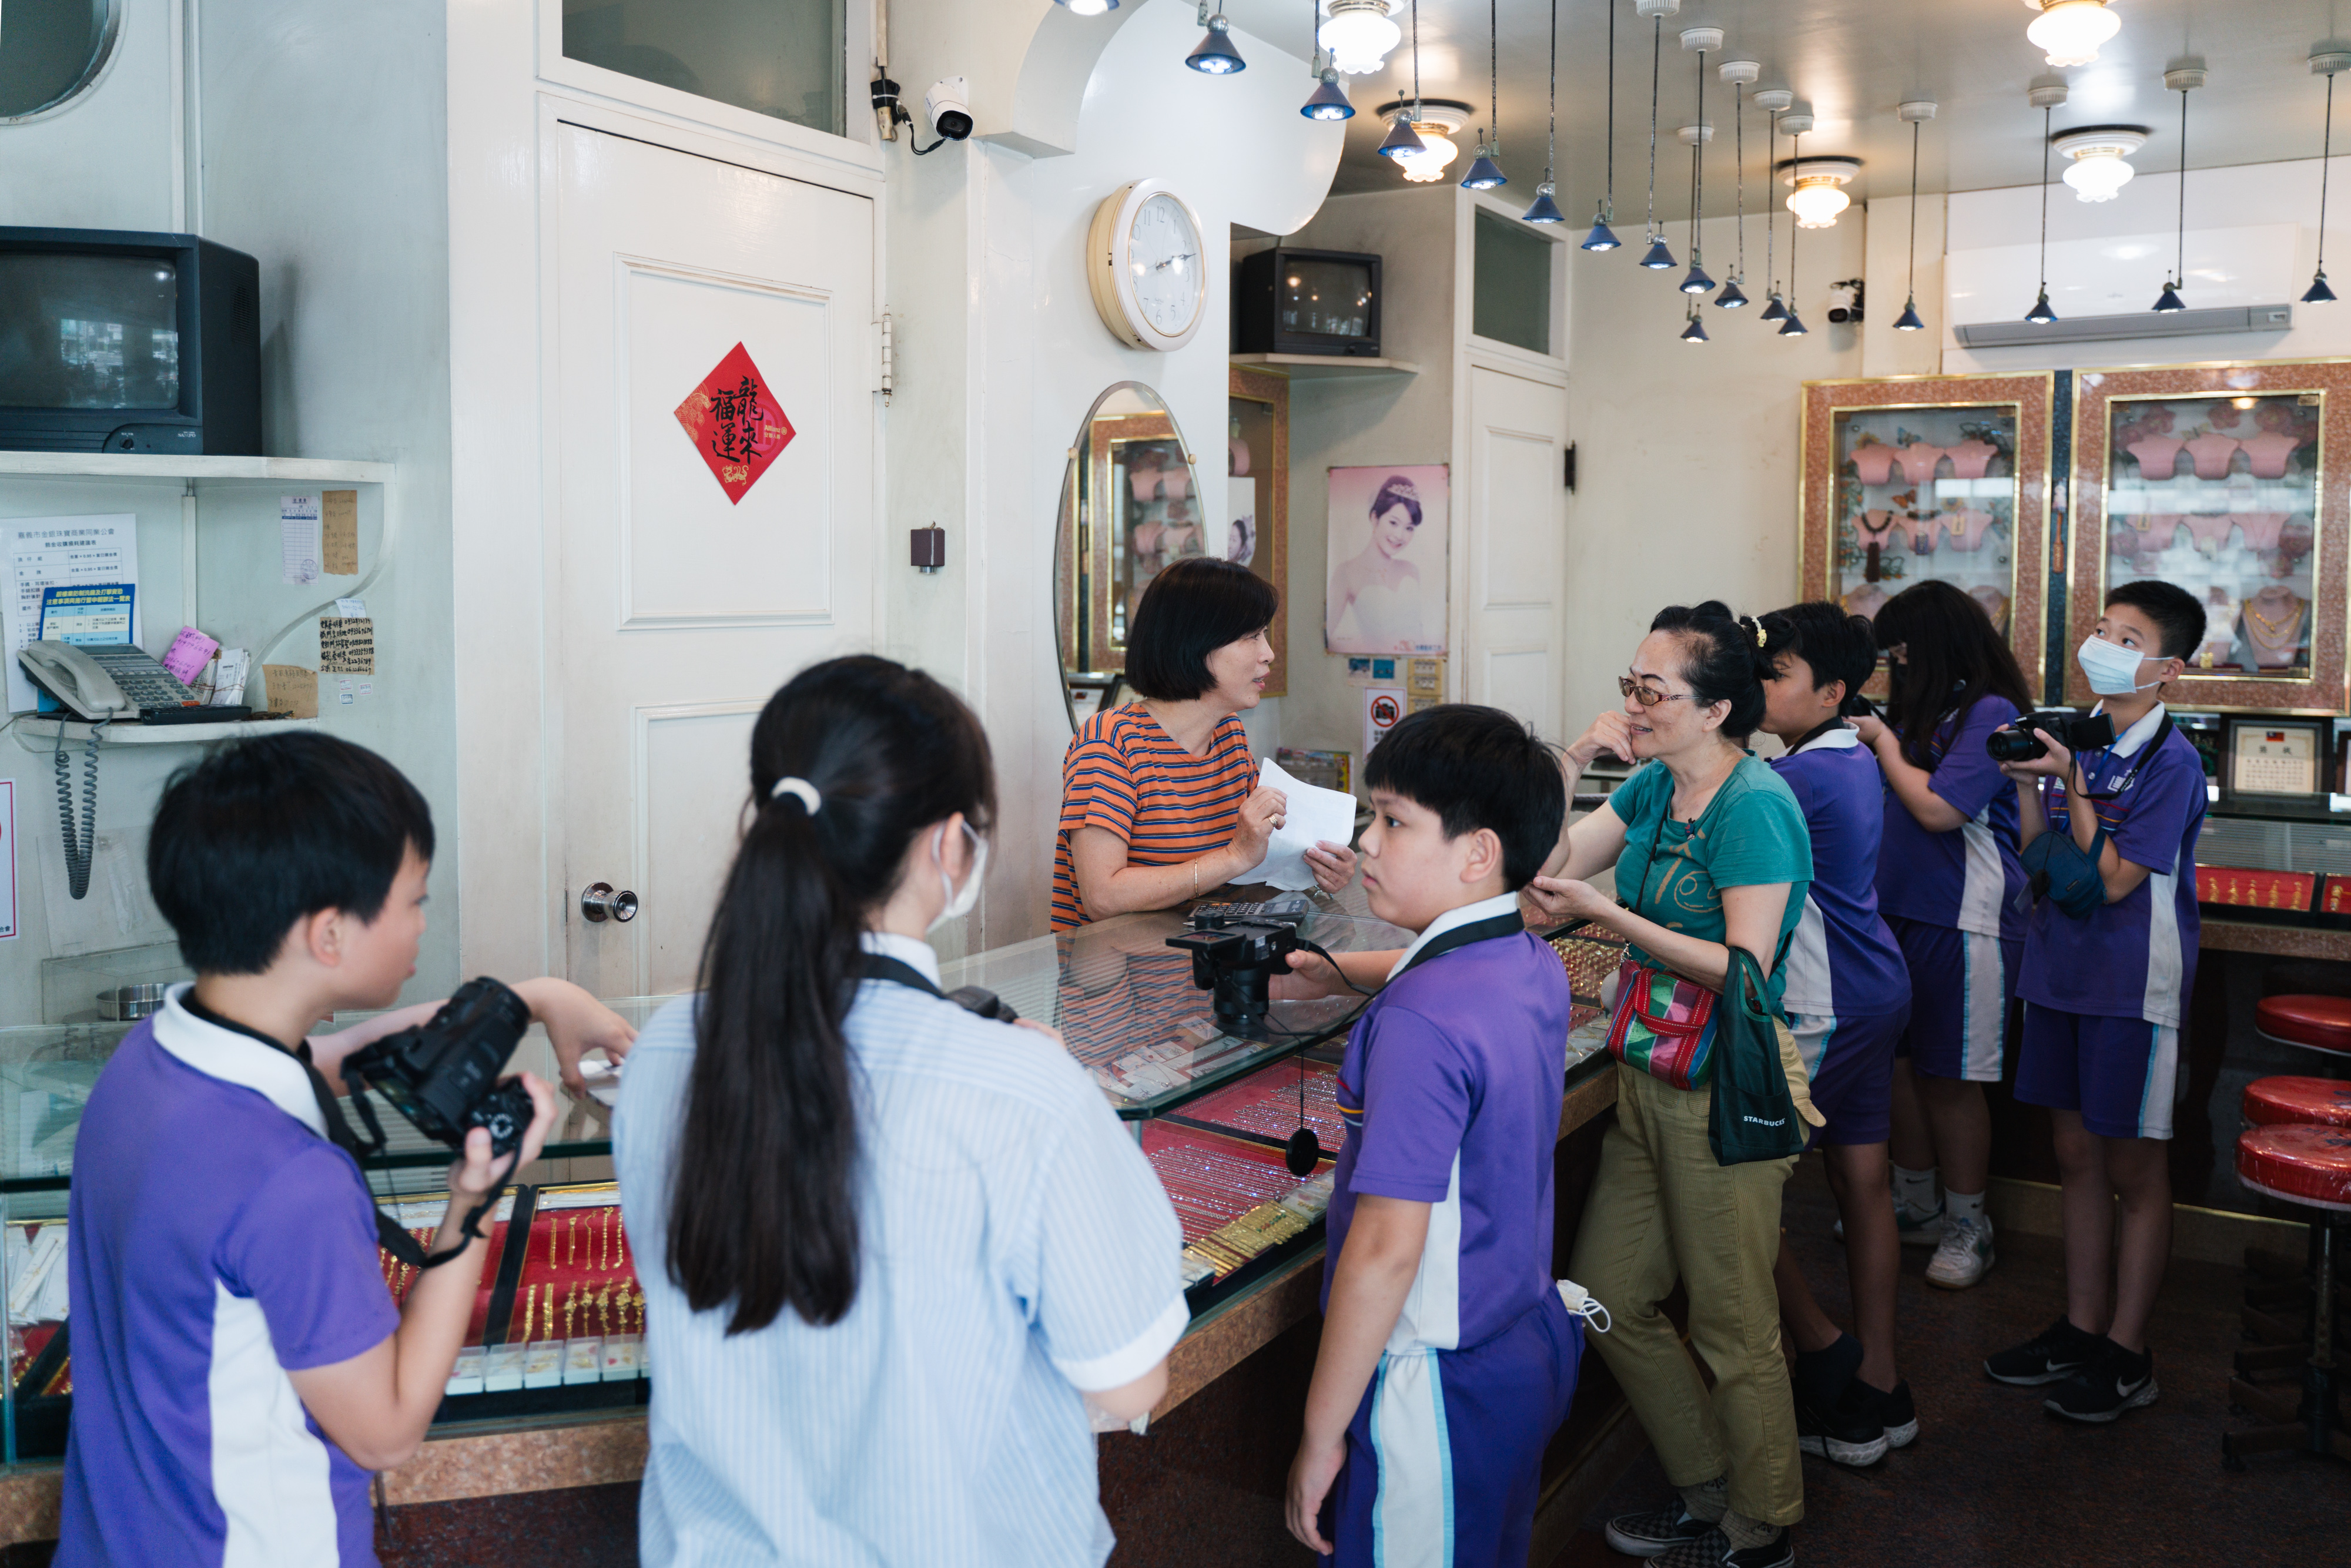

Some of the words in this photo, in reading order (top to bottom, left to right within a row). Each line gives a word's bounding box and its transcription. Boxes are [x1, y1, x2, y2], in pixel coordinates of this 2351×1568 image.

[1144, 209, 1150, 226] 11
[1157, 206, 1164, 223] 12
[1131, 224, 1141, 240] 0
[1184, 267, 1190, 282] 3
[1133, 276, 1138, 292] 8
[1144, 297, 1148, 313] 7
[1180, 291, 1185, 306] 4
[1156, 309, 1162, 324] 6
[1171, 304, 1175, 321] 5
[765, 424, 781, 433] Allianz
[18, 528, 115, 539] 嘉義市金銀珠寶商業同業公會
[1743, 1115, 1786, 1127] STARBUCKS
